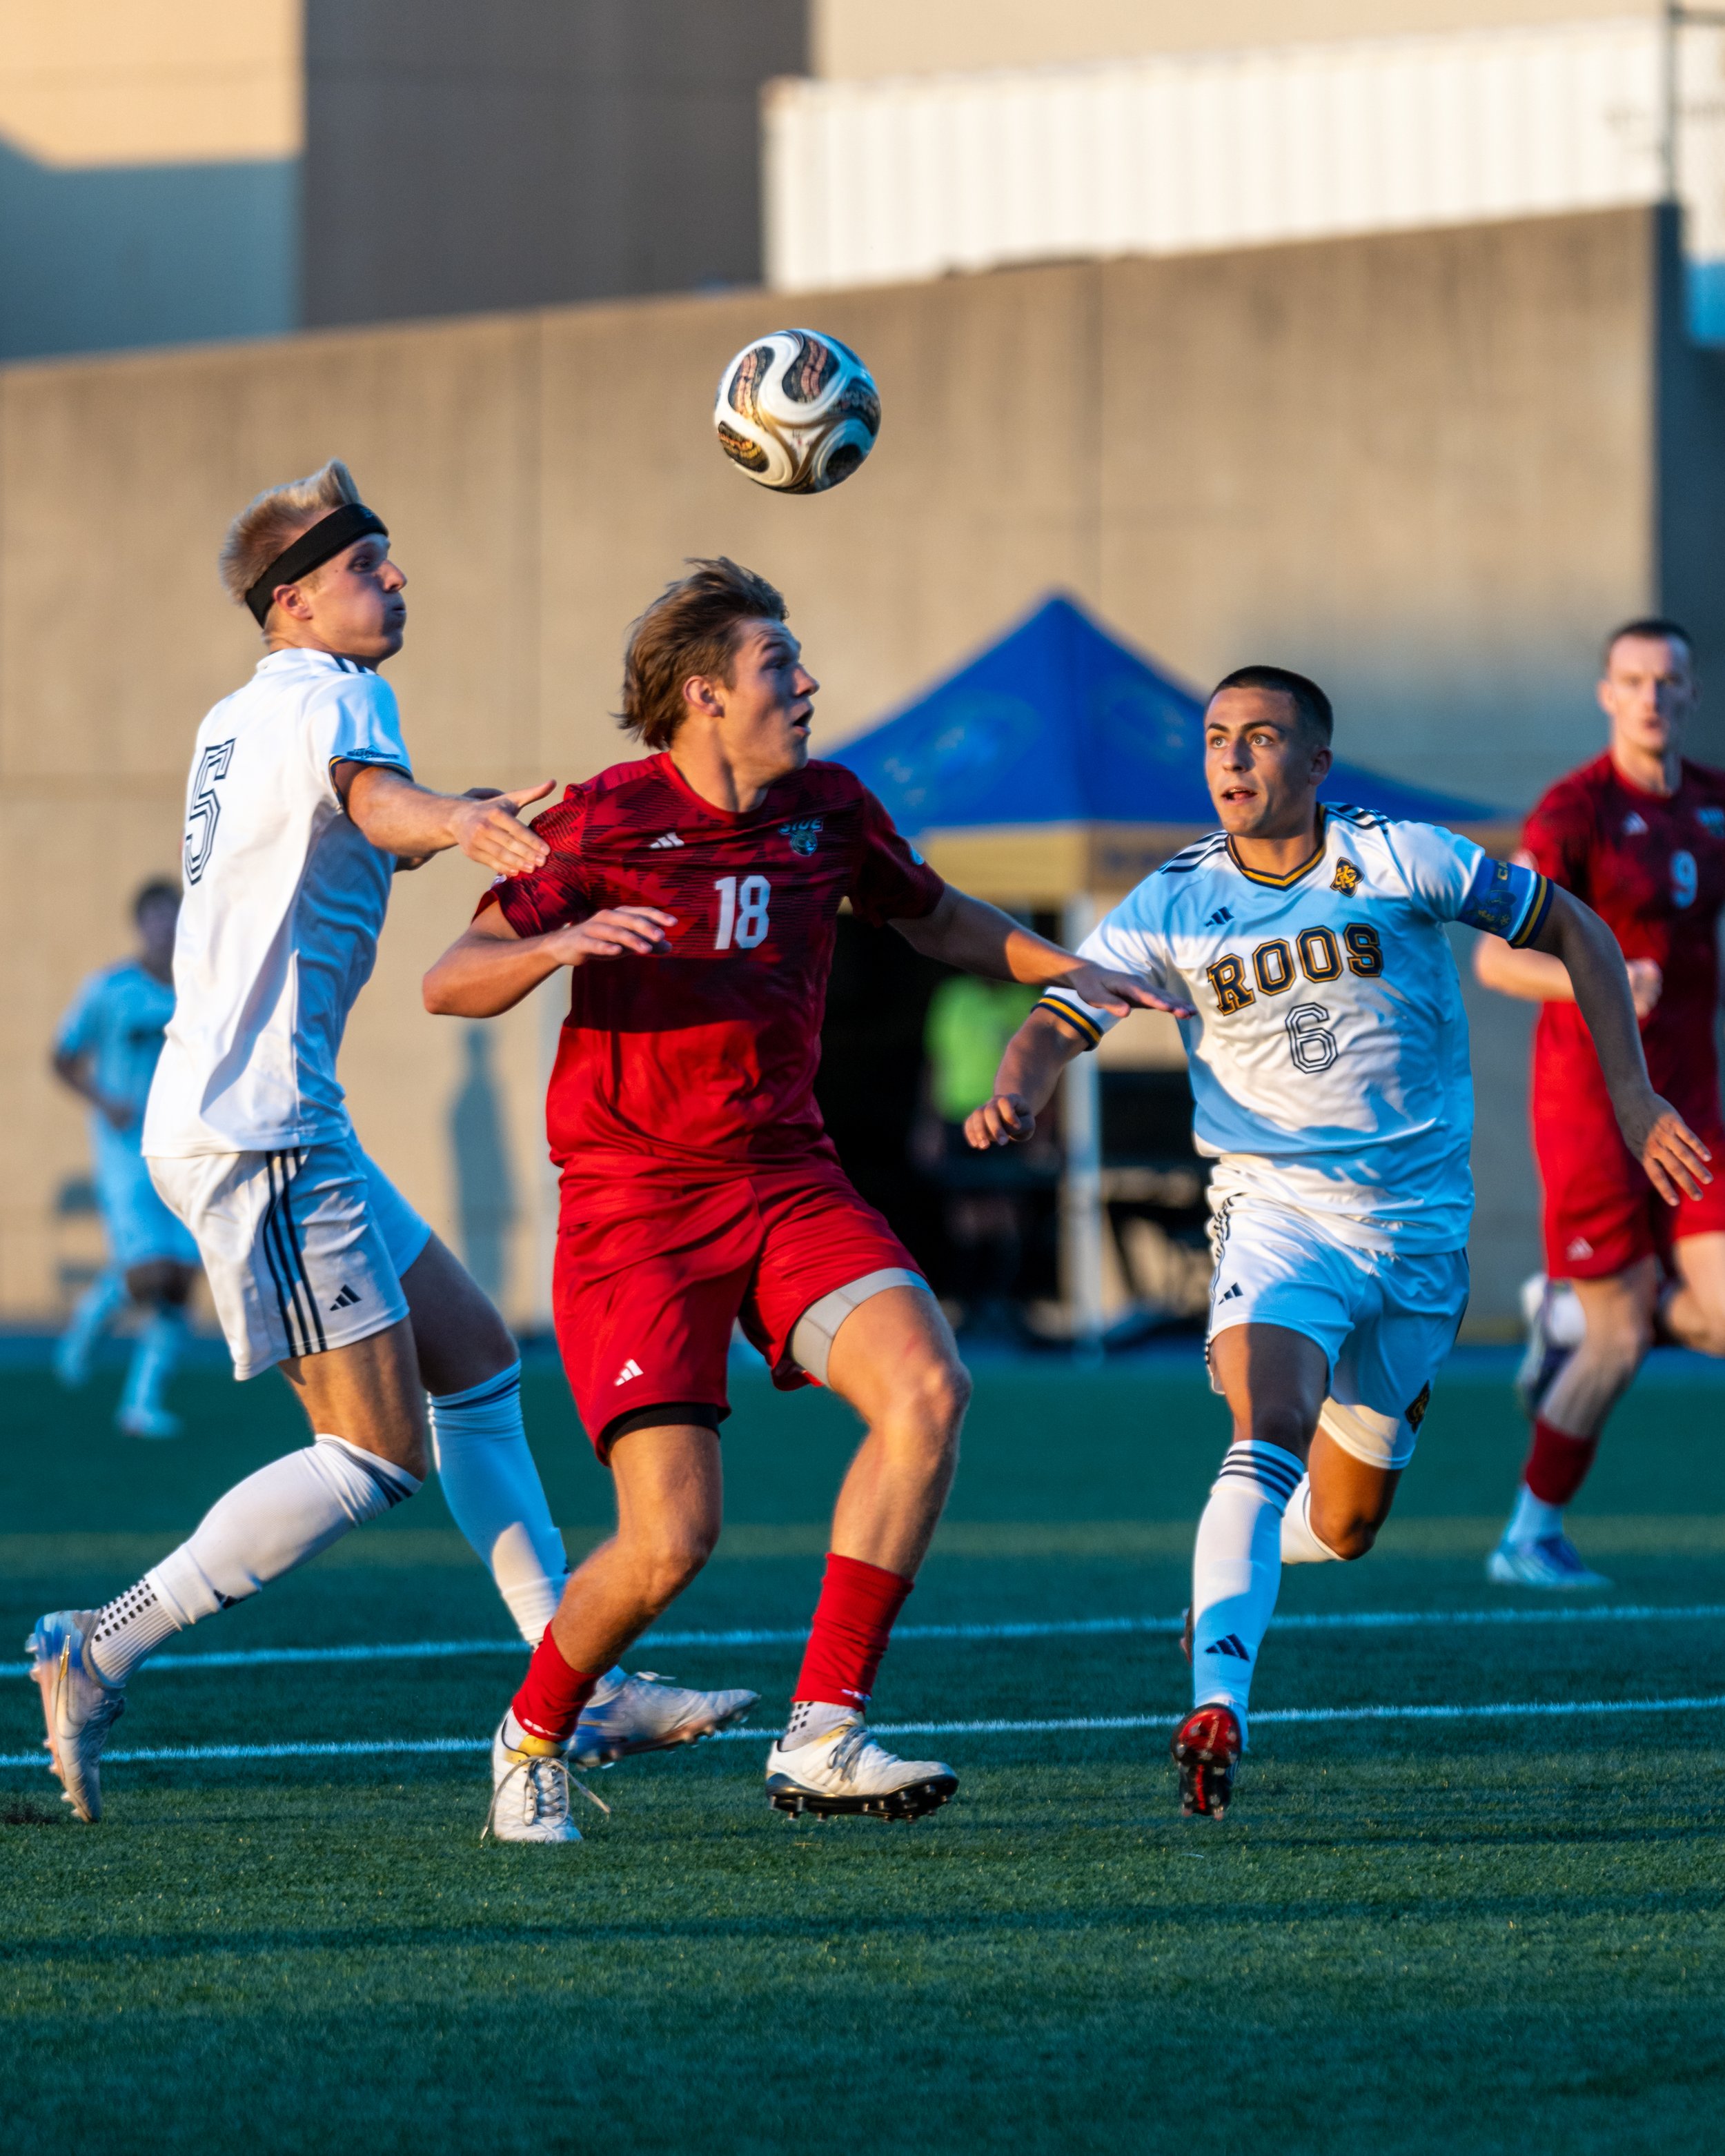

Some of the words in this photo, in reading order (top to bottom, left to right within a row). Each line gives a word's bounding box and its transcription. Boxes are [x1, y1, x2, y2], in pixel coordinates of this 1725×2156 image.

[186, 737, 237, 886] 5
[714, 874, 771, 949] 18
[1670, 850, 1697, 909] 9
[1206, 922, 1384, 1016] ROOS
[1285, 1002, 1339, 1074] 6
